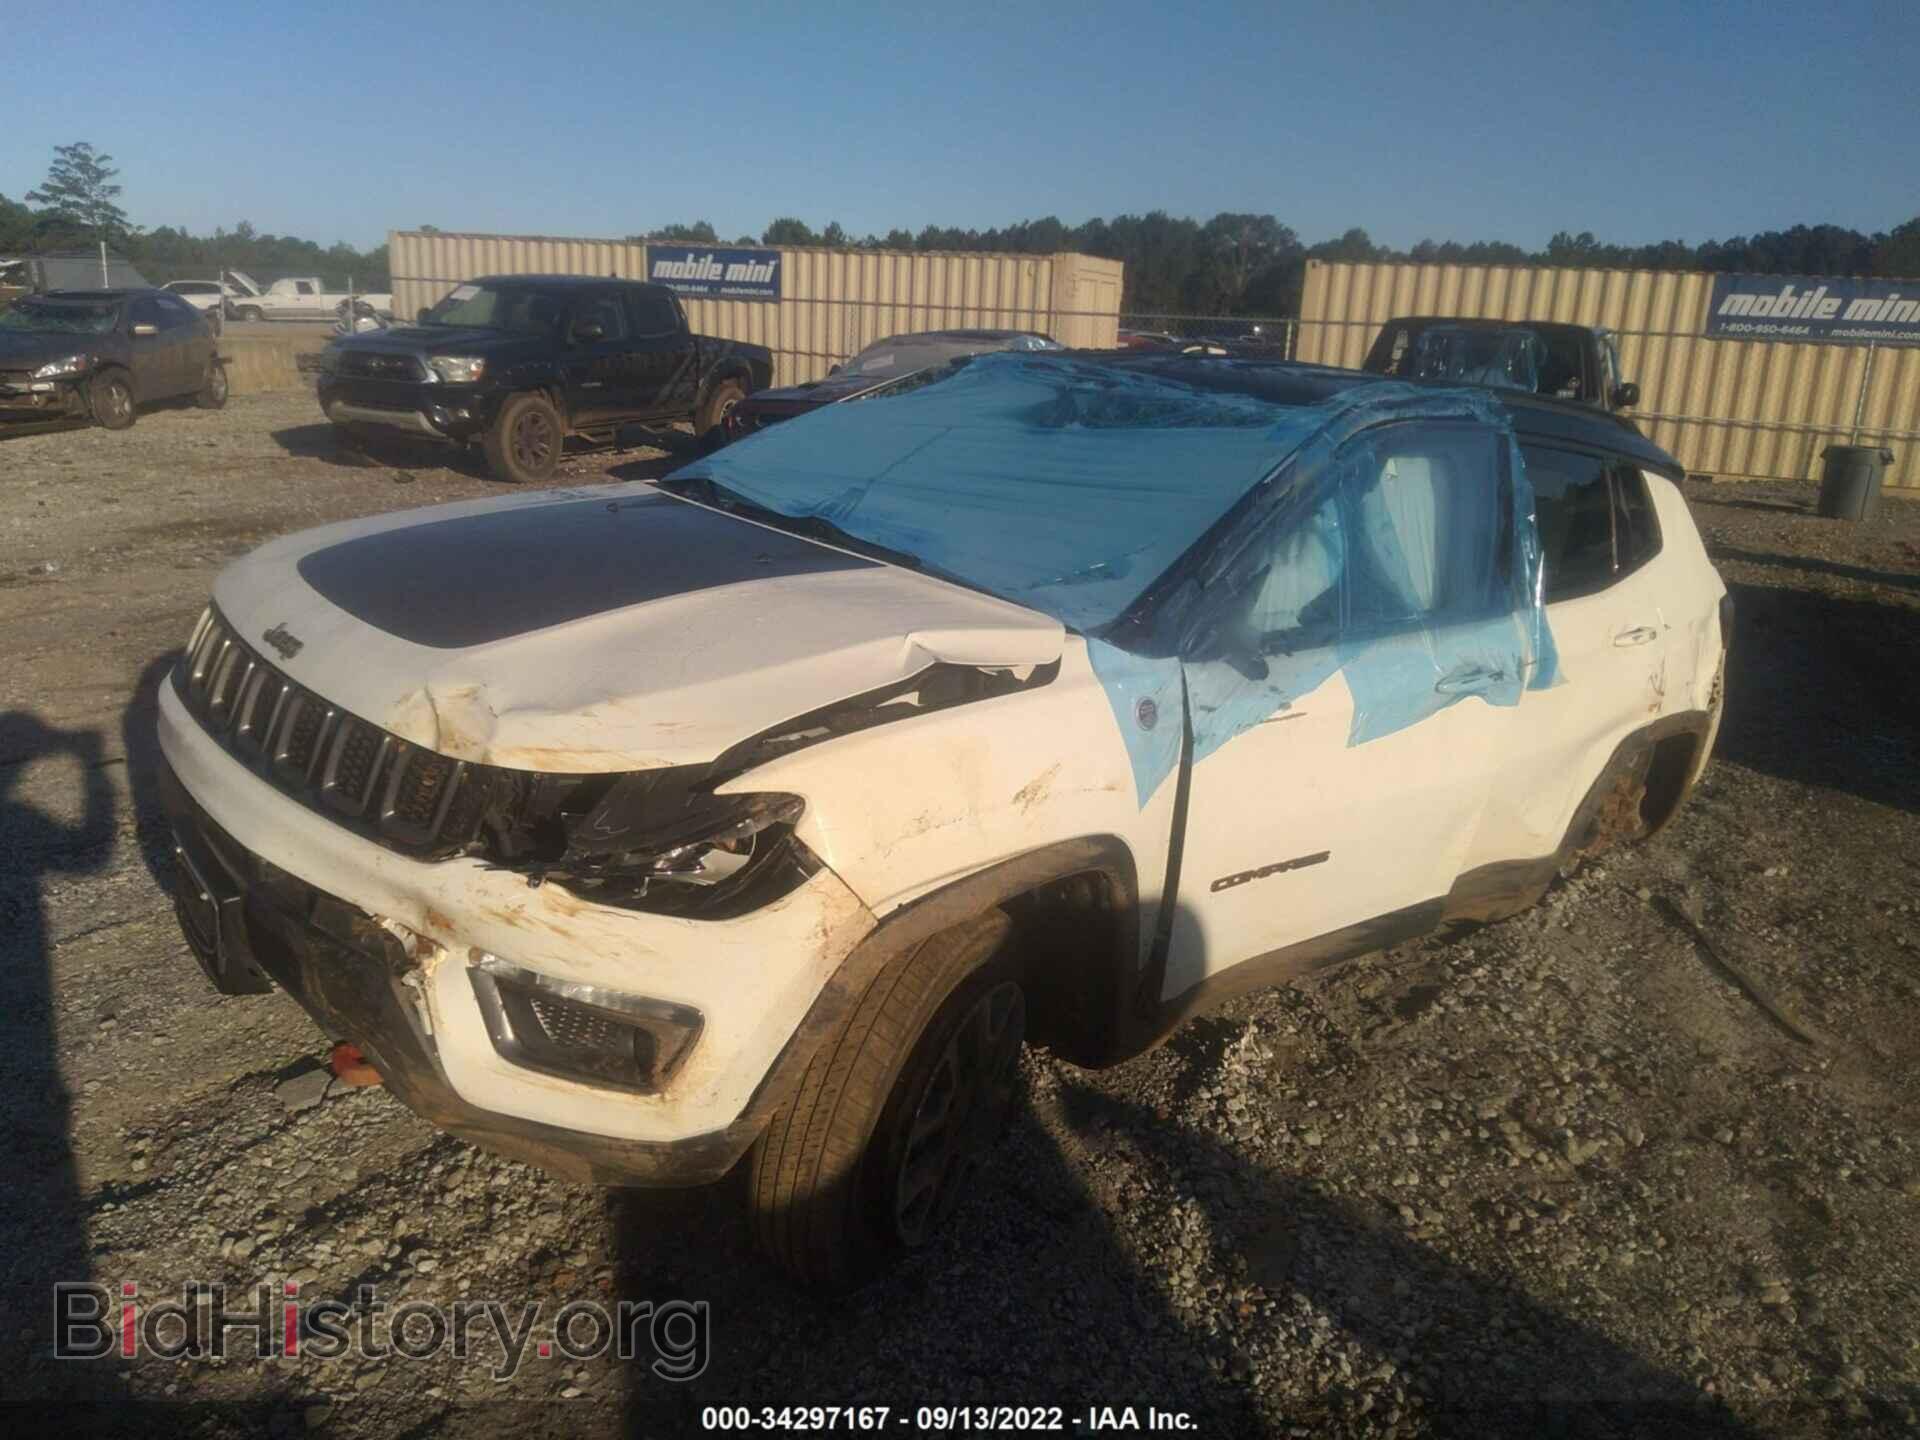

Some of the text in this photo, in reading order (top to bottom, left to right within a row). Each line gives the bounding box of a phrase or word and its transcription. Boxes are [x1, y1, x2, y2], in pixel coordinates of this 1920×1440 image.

[653, 254, 777, 283] mobile mini
[1718, 285, 1842, 319] mobile
